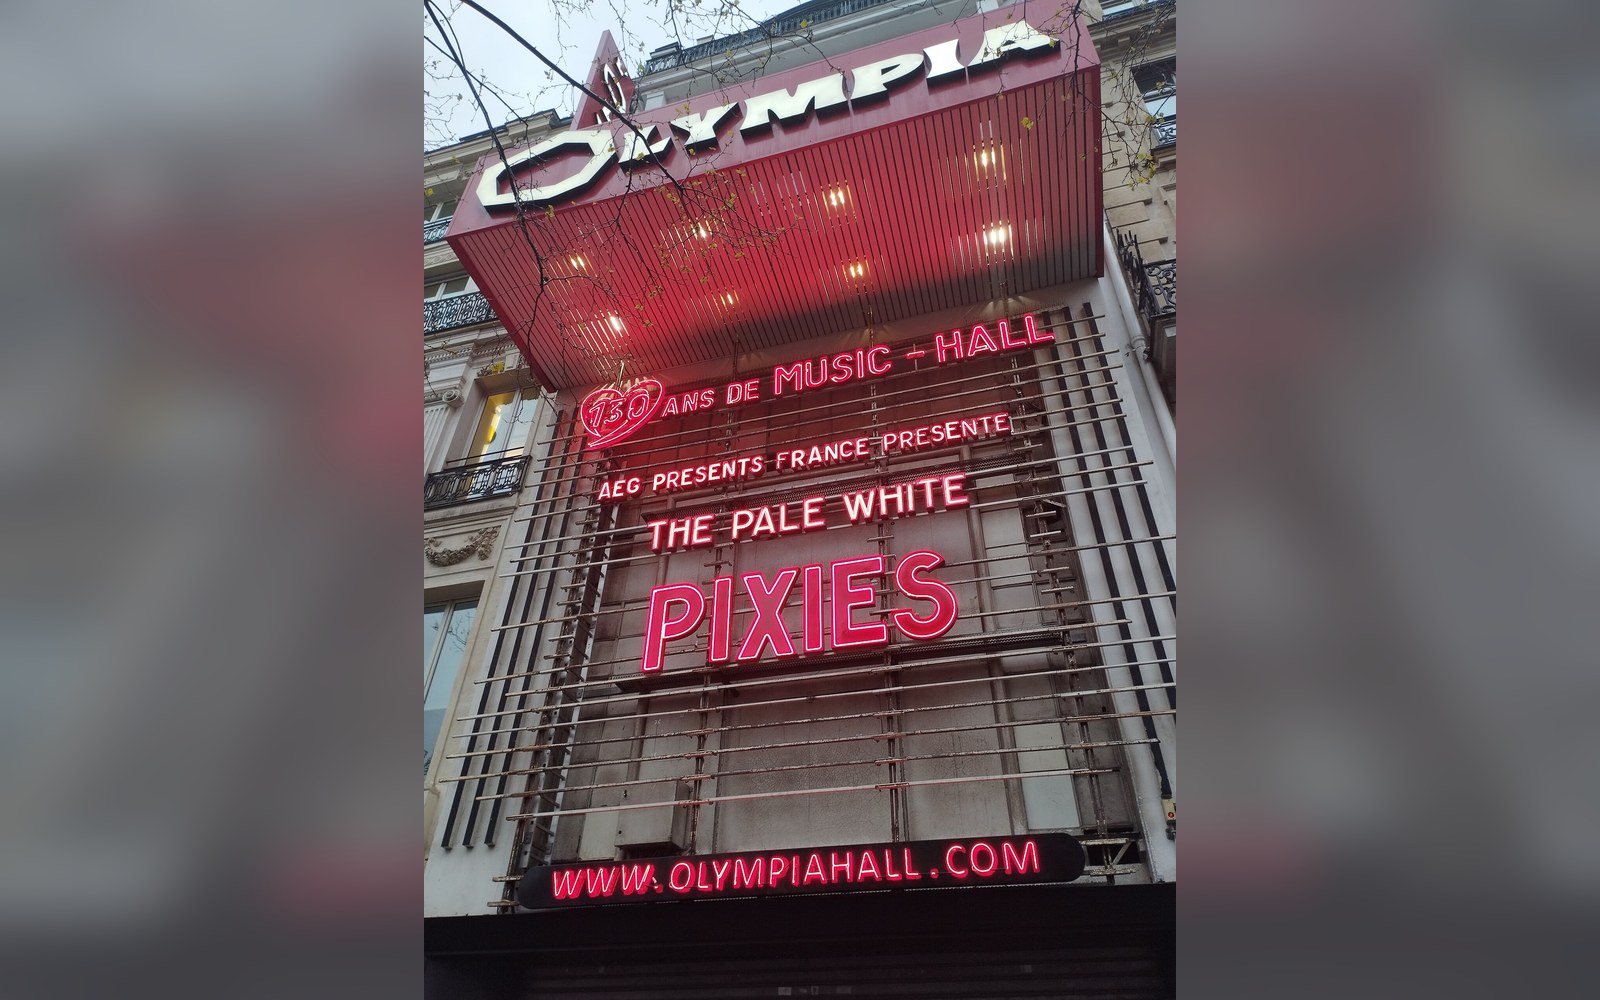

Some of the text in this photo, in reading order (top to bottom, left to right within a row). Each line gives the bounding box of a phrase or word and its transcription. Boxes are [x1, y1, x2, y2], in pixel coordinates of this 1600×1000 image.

[477, 21, 1060, 212] OLYMPIA
[661, 390, 715, 417] ANS
[727, 380, 761, 405] DE
[774, 346, 893, 396] MUSIC
[935, 314, 1055, 364] HALL
[597, 411, 1010, 501] AEG PRESENTS FRANCE PRESENTE
[648, 473, 971, 551] THE PALE WHITE
[641, 551, 959, 673] PIXIES
